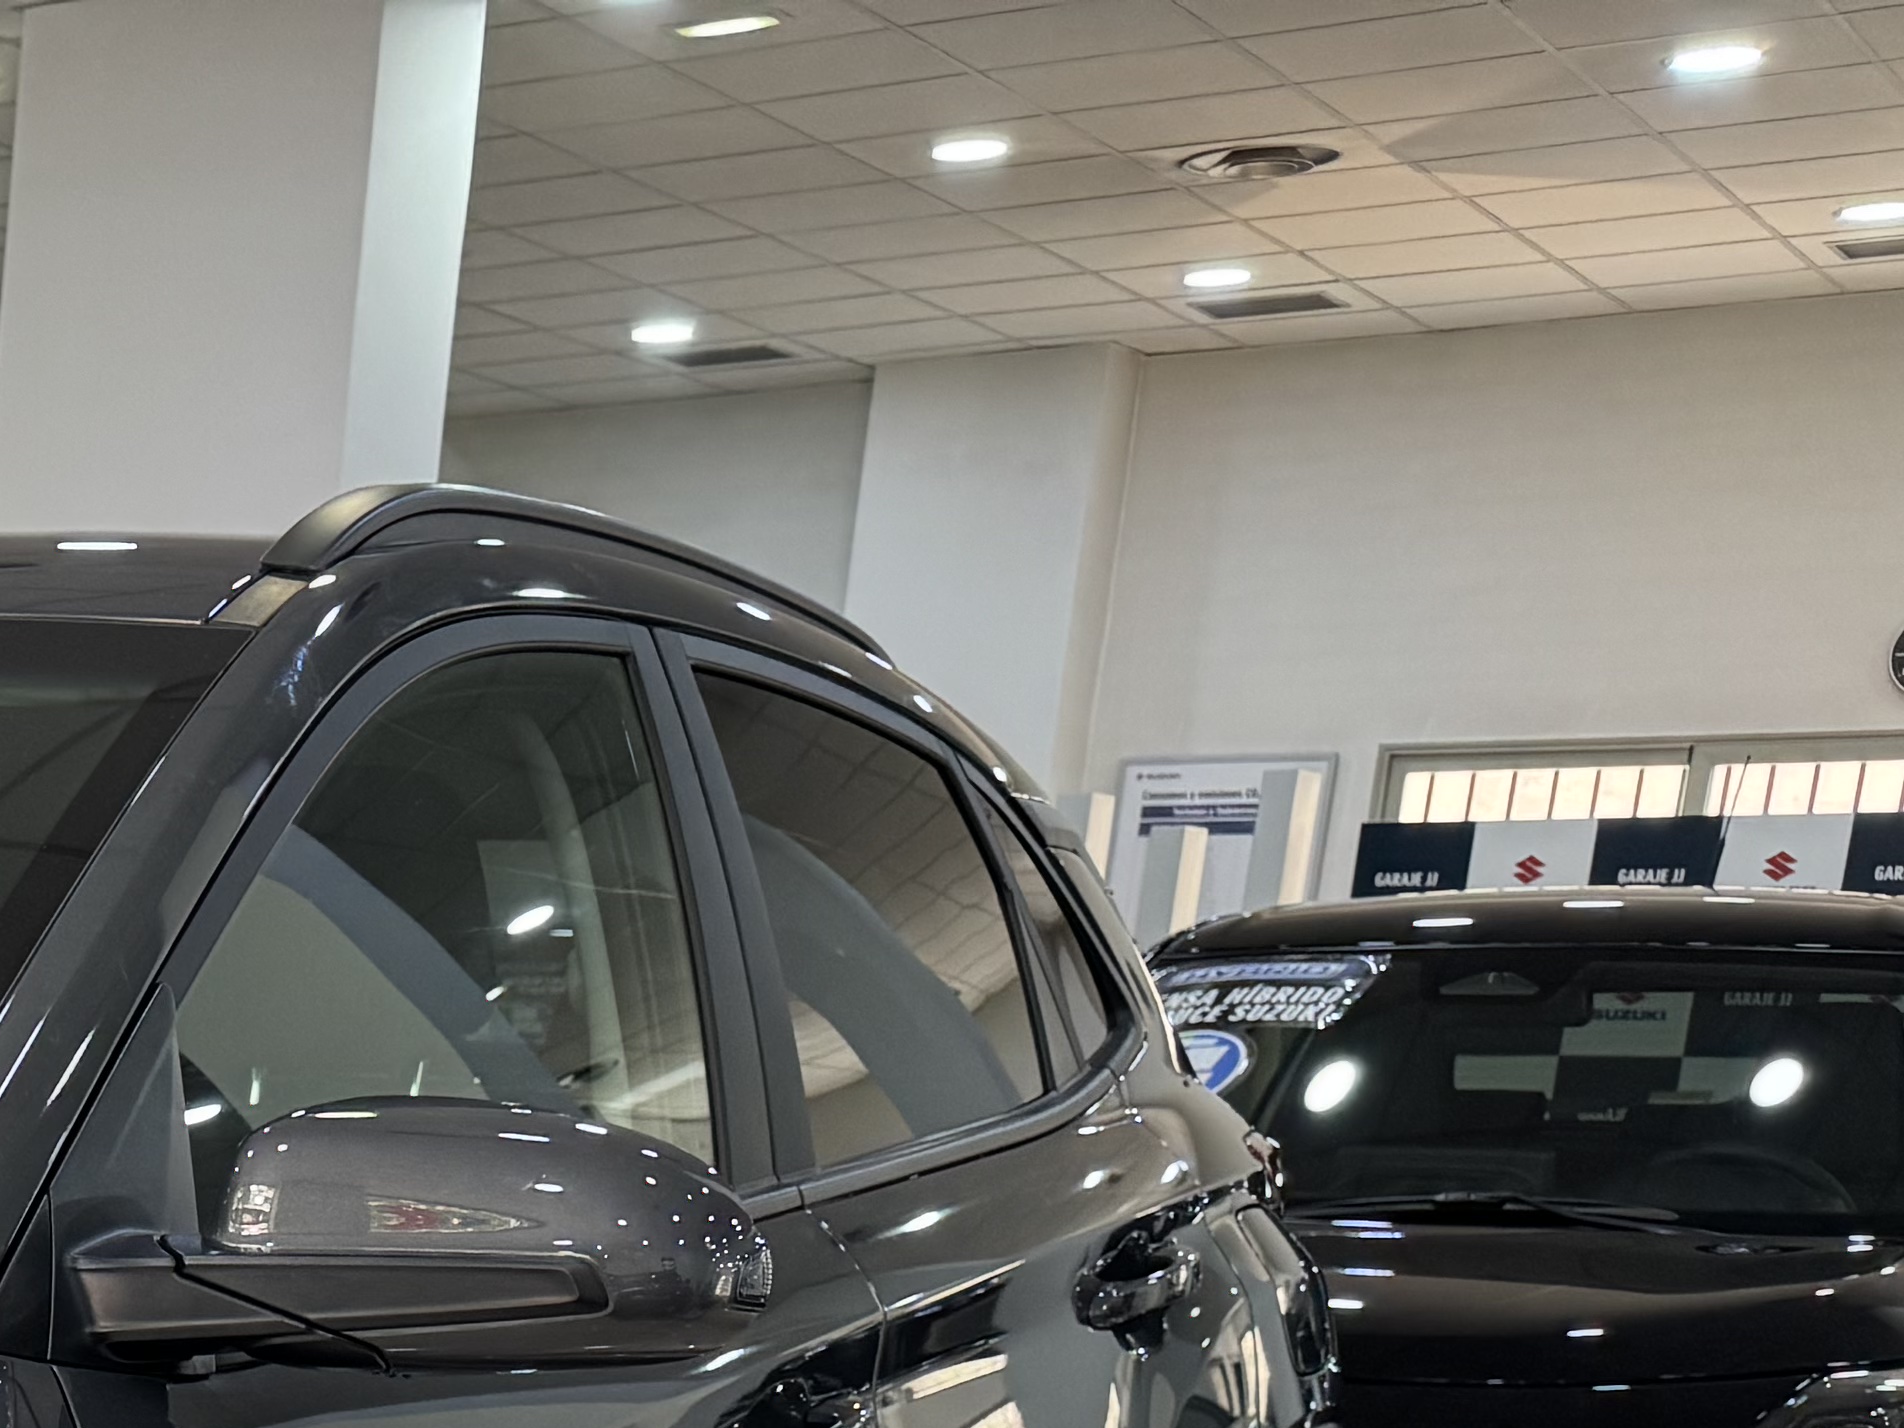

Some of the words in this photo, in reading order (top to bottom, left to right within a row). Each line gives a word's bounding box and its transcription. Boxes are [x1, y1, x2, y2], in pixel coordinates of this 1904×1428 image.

[1374, 870, 1425, 888] GARAJE
[1425, 870, 1439, 887] JJ
[1617, 868, 1671, 886] GARAJE
[1671, 867, 1686, 884] JJ
[1874, 865, 1904, 881] GAR
[1223, 983, 1346, 1006] HÍBRIDO
[1168, 1003, 1229, 1026] UCE
